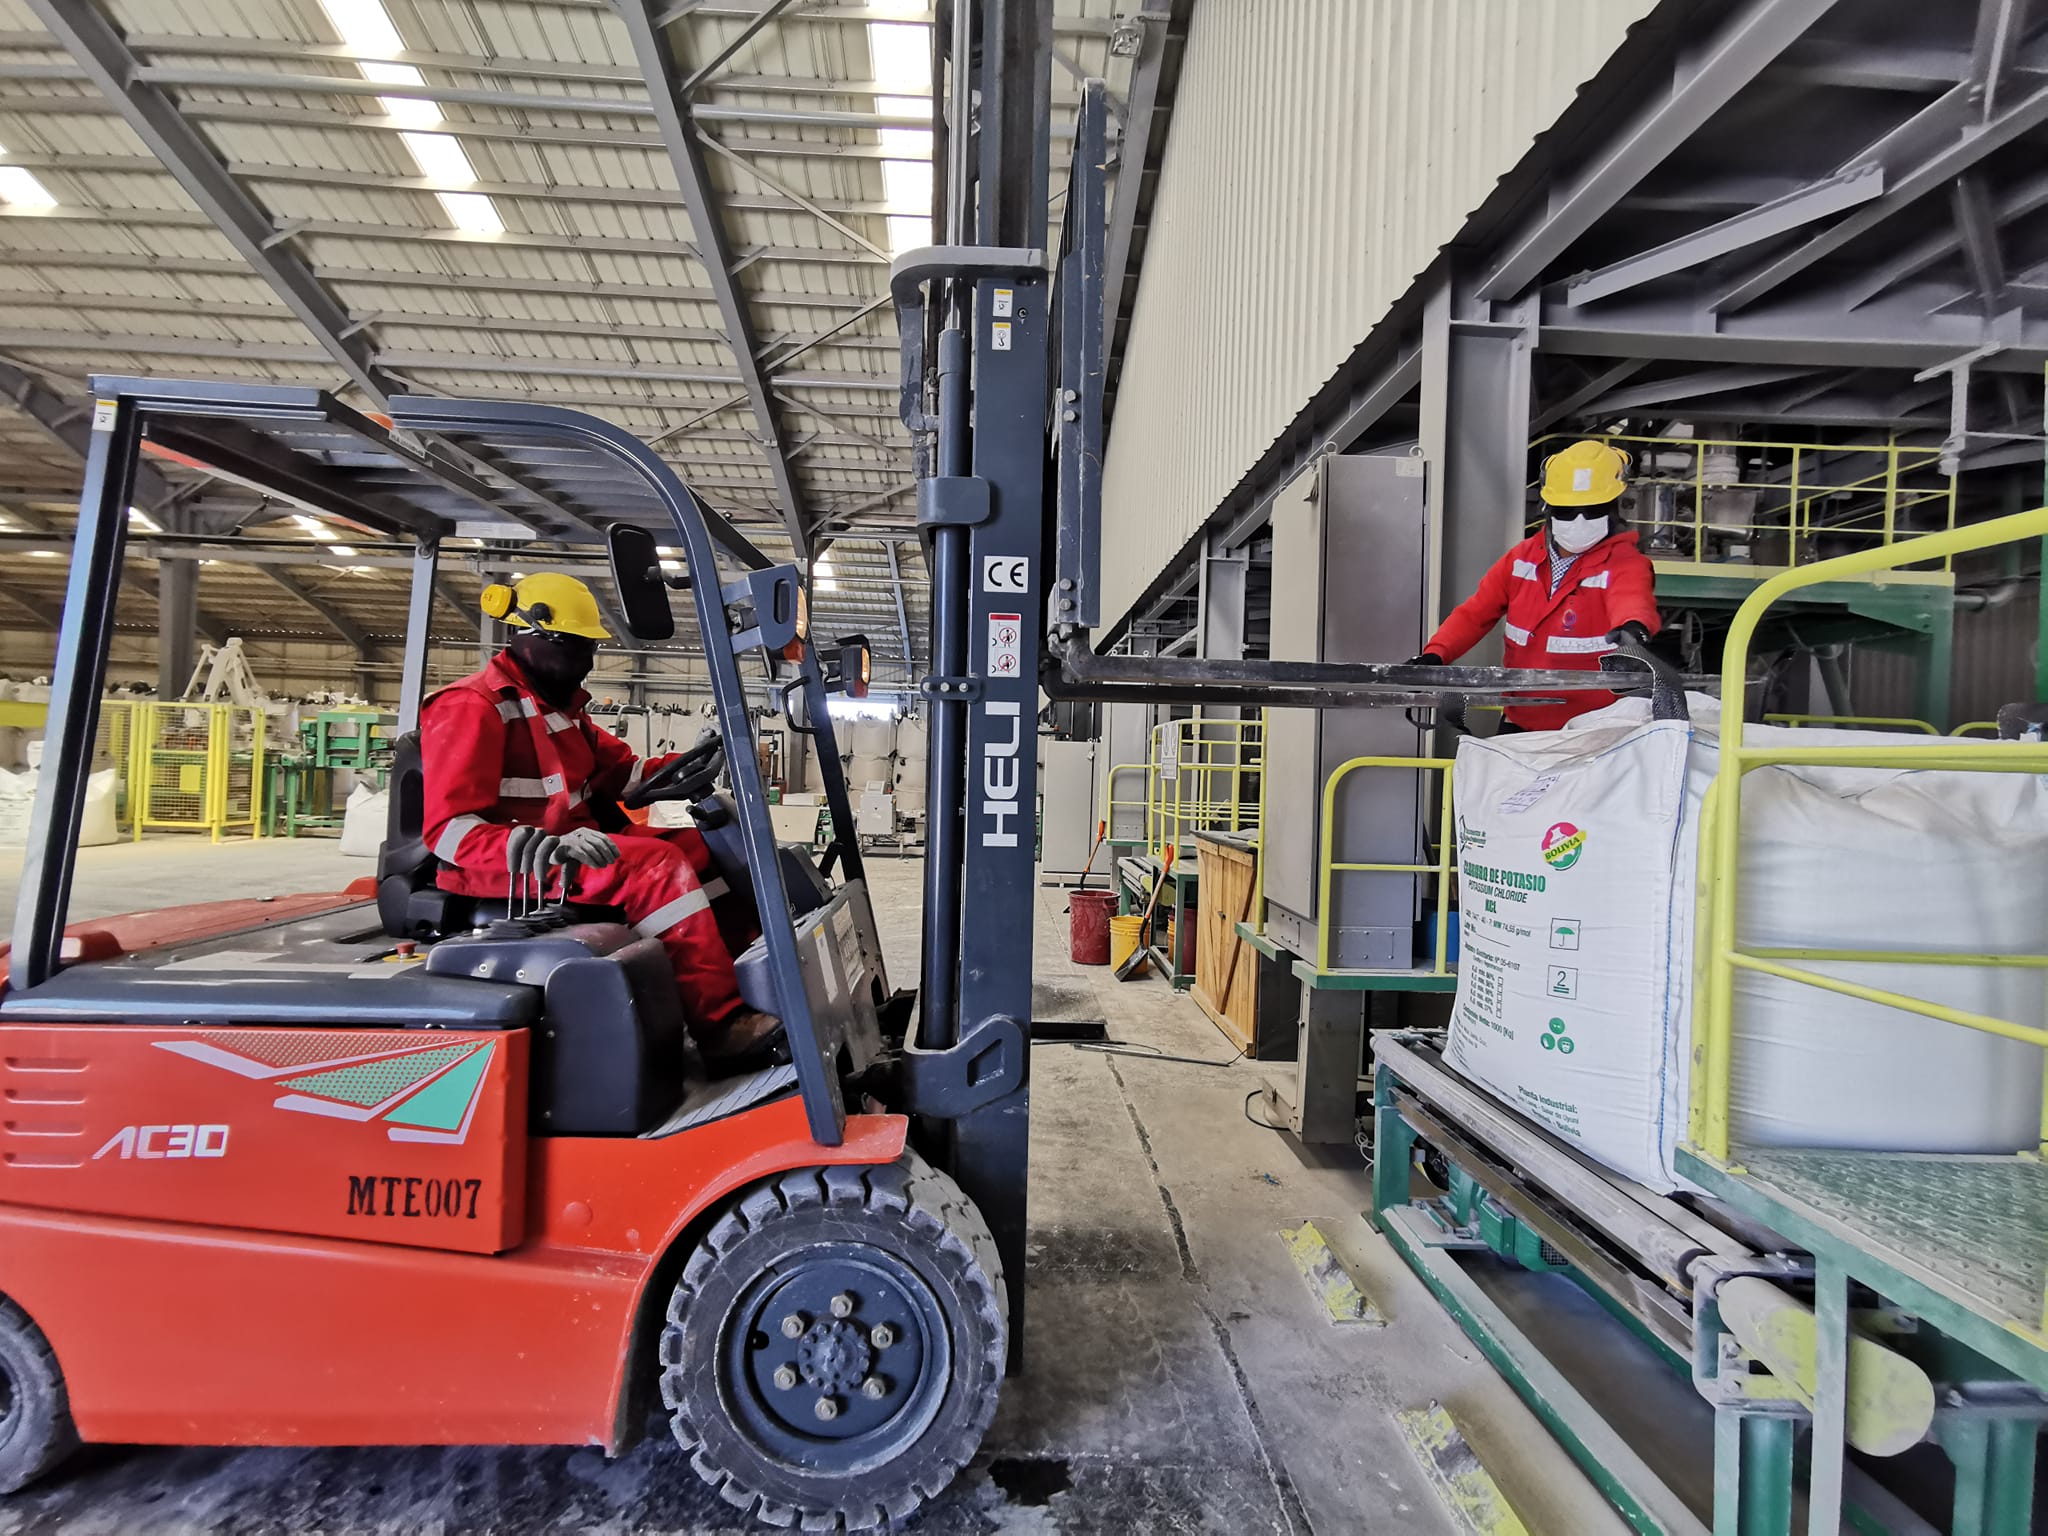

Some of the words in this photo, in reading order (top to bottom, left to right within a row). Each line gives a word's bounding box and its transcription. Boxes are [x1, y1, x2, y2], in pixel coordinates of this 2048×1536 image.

[987, 561, 1025, 588] CE
[982, 701, 1021, 848] HELI
[1544, 836, 1580, 860] BOLIVIA
[1468, 879, 1493, 896] POTASSIUM
[1494, 887, 1528, 903] CHLORIDE
[1489, 867, 1500, 884] DE
[1500, 871, 1546, 893] POTASIO
[1557, 970, 1567, 987] 2
[1538, 1094, 1578, 1114] Industrial:
[92, 1125, 229, 1159] AC30
[347, 1175, 482, 1219] MTE007
